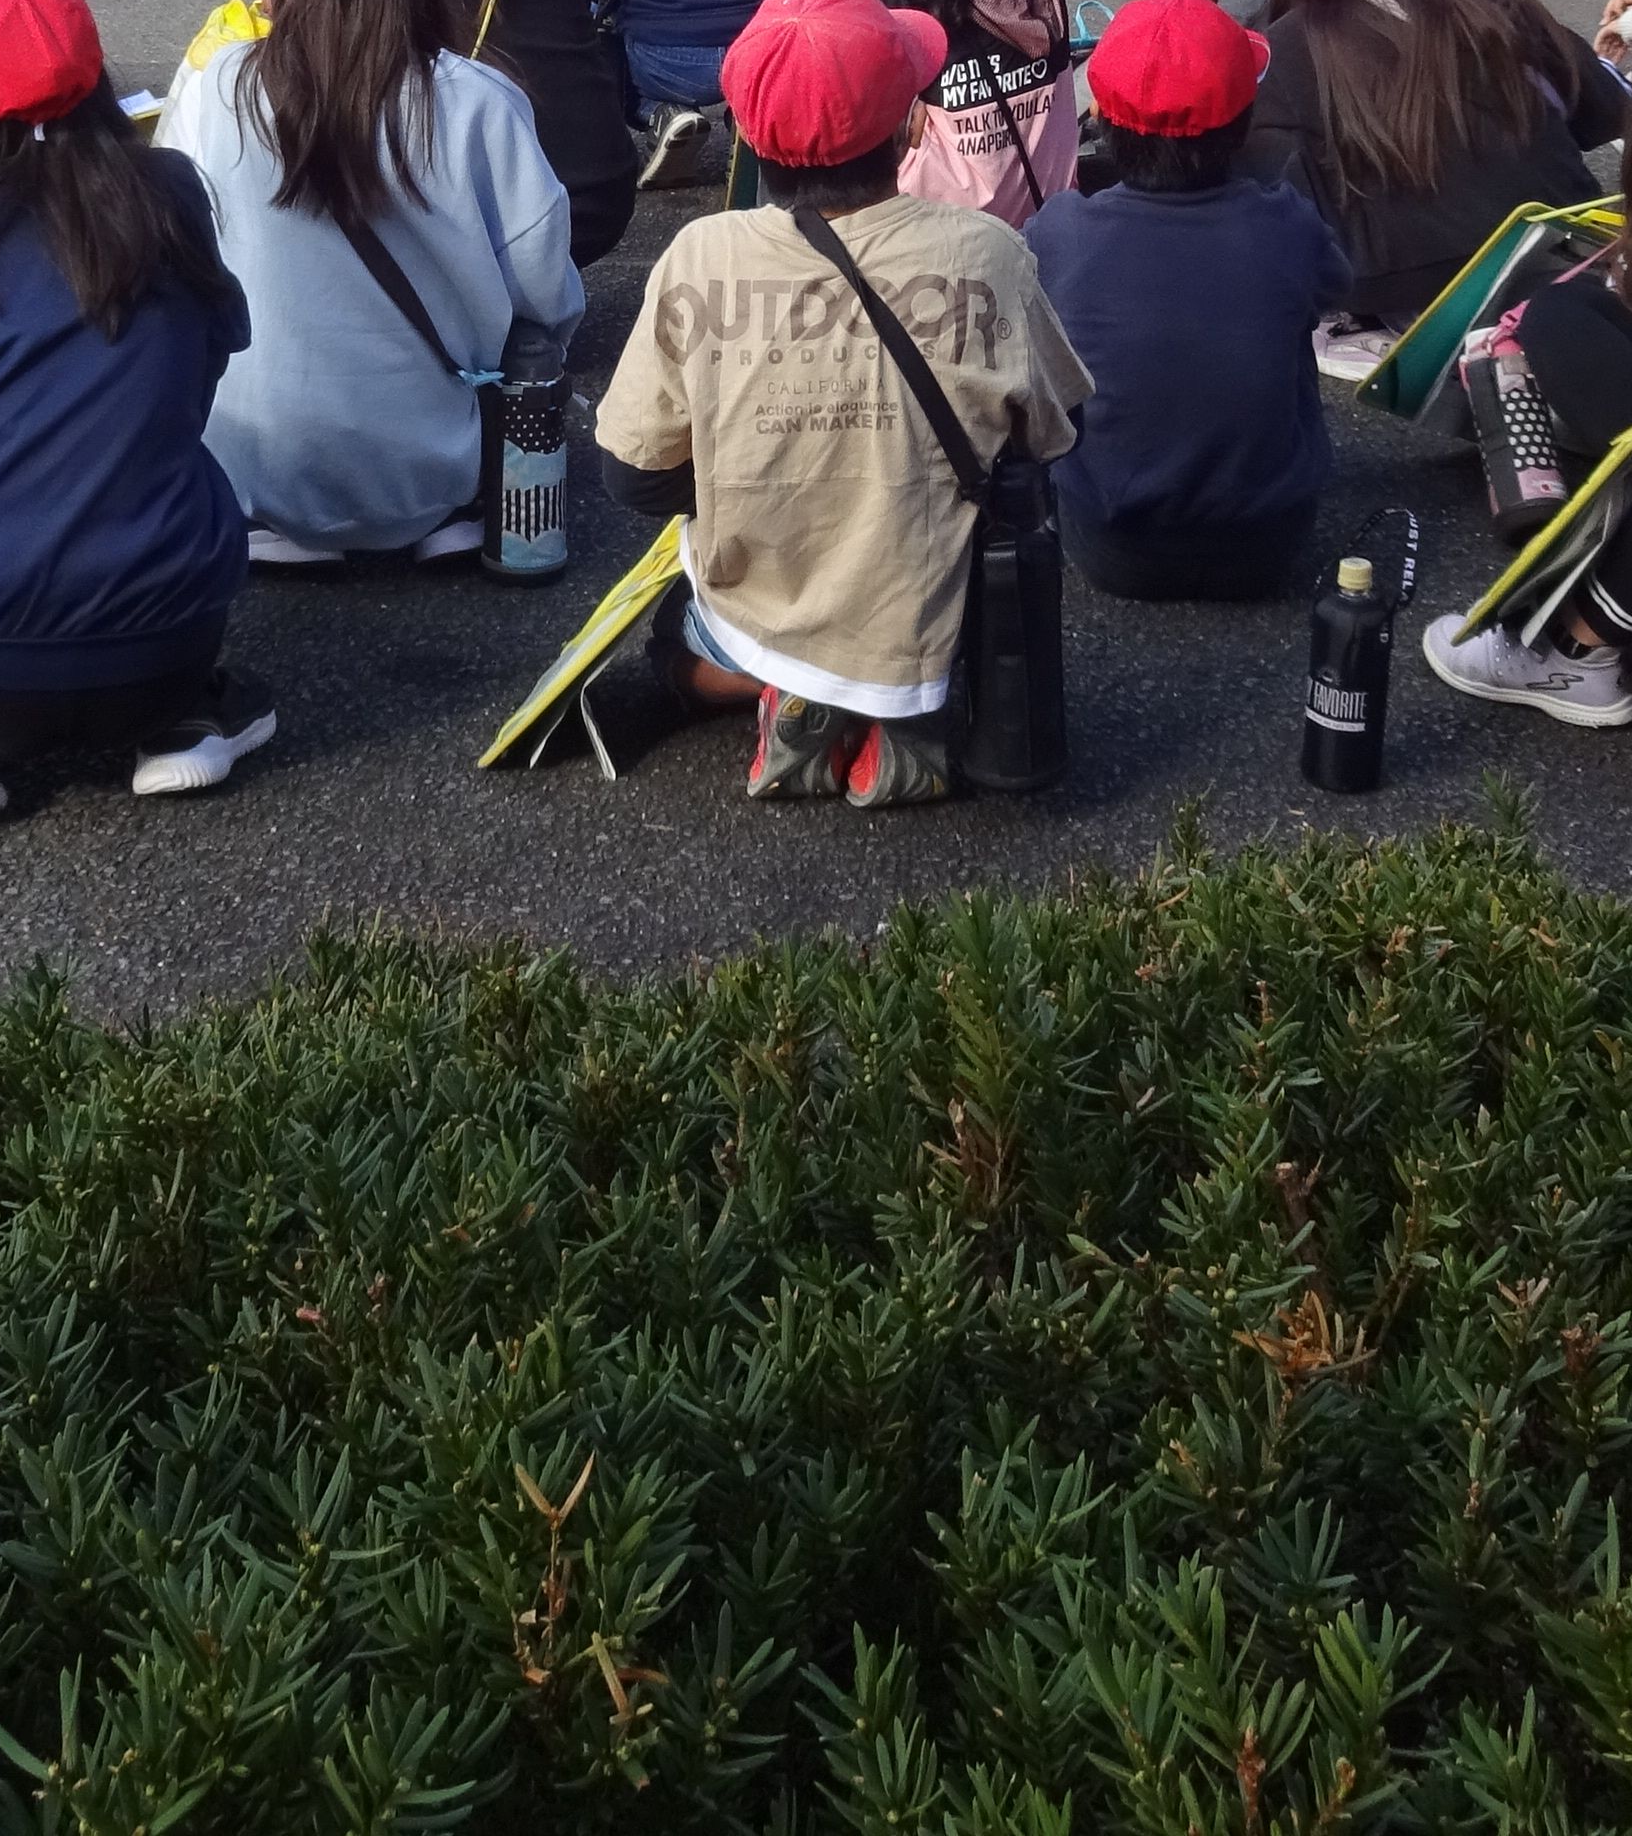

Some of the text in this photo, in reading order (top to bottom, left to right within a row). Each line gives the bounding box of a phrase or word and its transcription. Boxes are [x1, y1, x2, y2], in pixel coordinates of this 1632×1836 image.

[943, 83, 968, 109] MY
[954, 110, 991, 135] TALK
[654, 273, 997, 371] OUTDOOR
[710, 340, 936, 365] PRODUCS
[755, 417, 802, 435] CAN
[1314, 681, 1368, 720] FAVORITE
